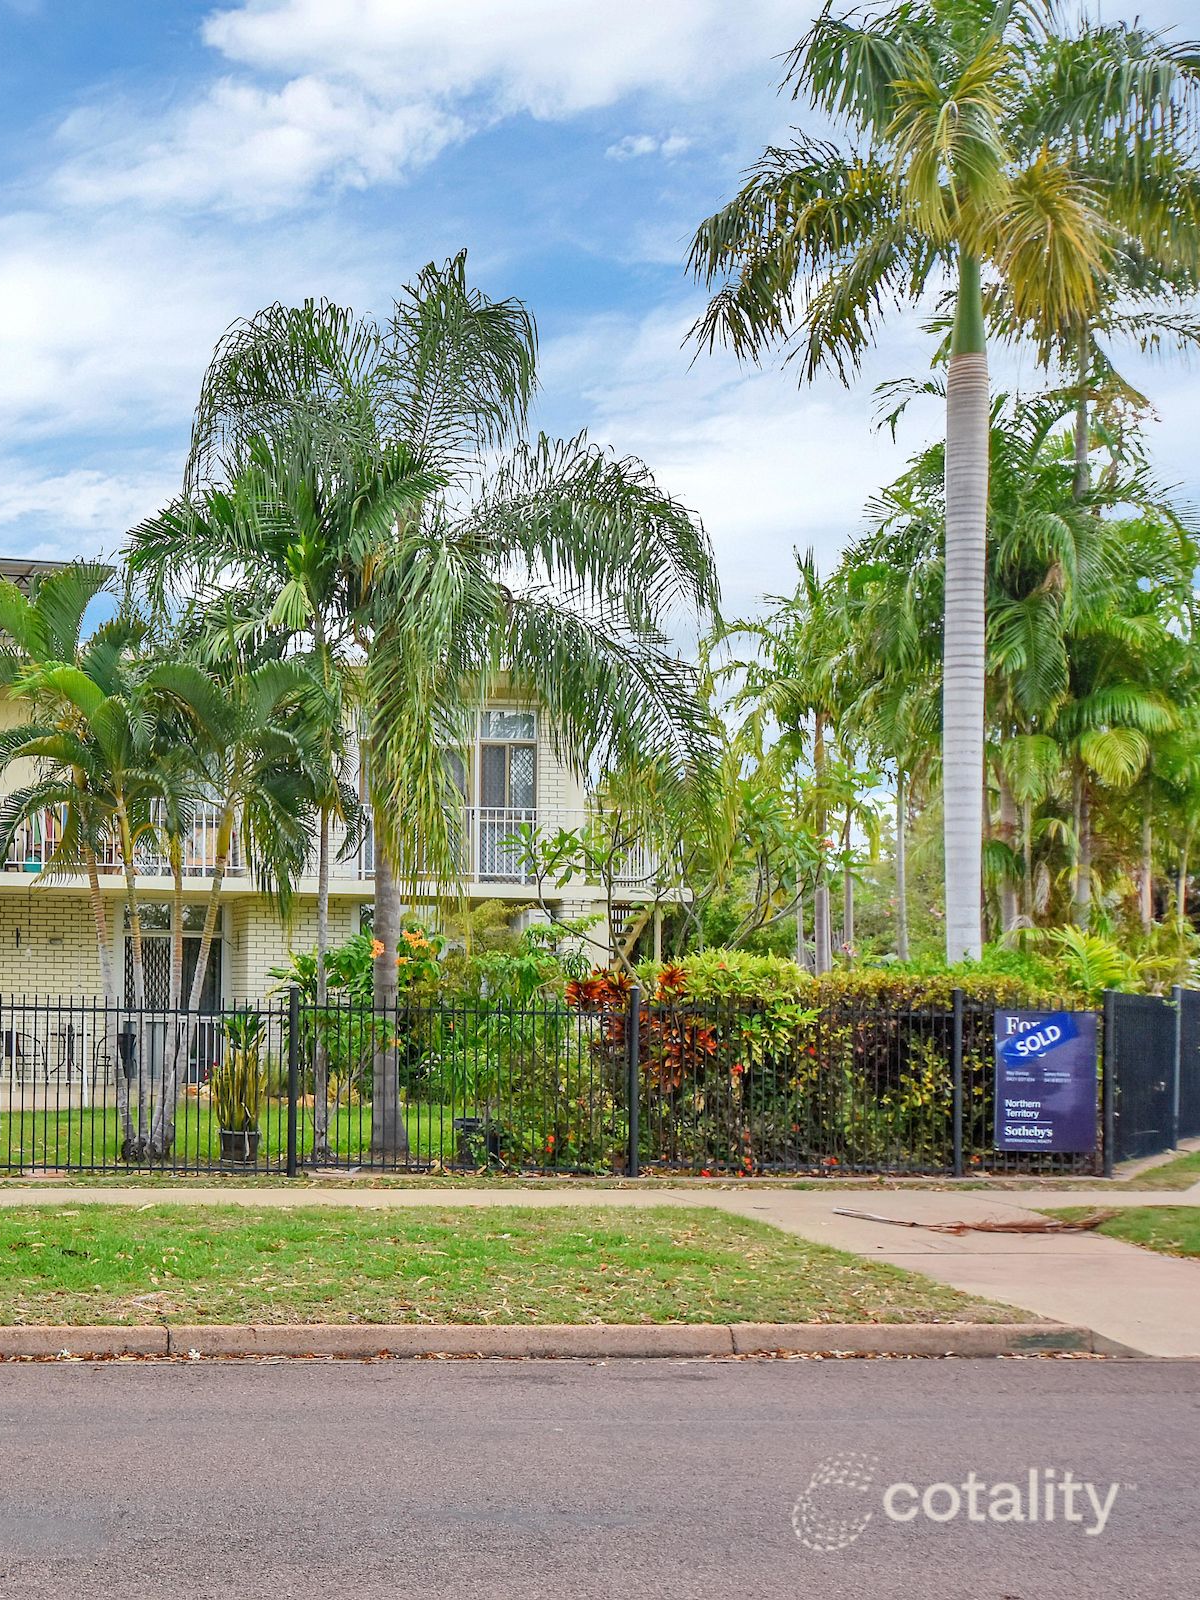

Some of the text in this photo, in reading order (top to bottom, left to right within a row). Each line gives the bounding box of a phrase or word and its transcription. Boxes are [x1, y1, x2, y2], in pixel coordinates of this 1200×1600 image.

[1015, 1025, 1061, 1056] SOLD
[1005, 1099, 1041, 1108] Northern
[1005, 1109, 1040, 1119] Territory
[1004, 1125, 1053, 1139] Sotheby's
